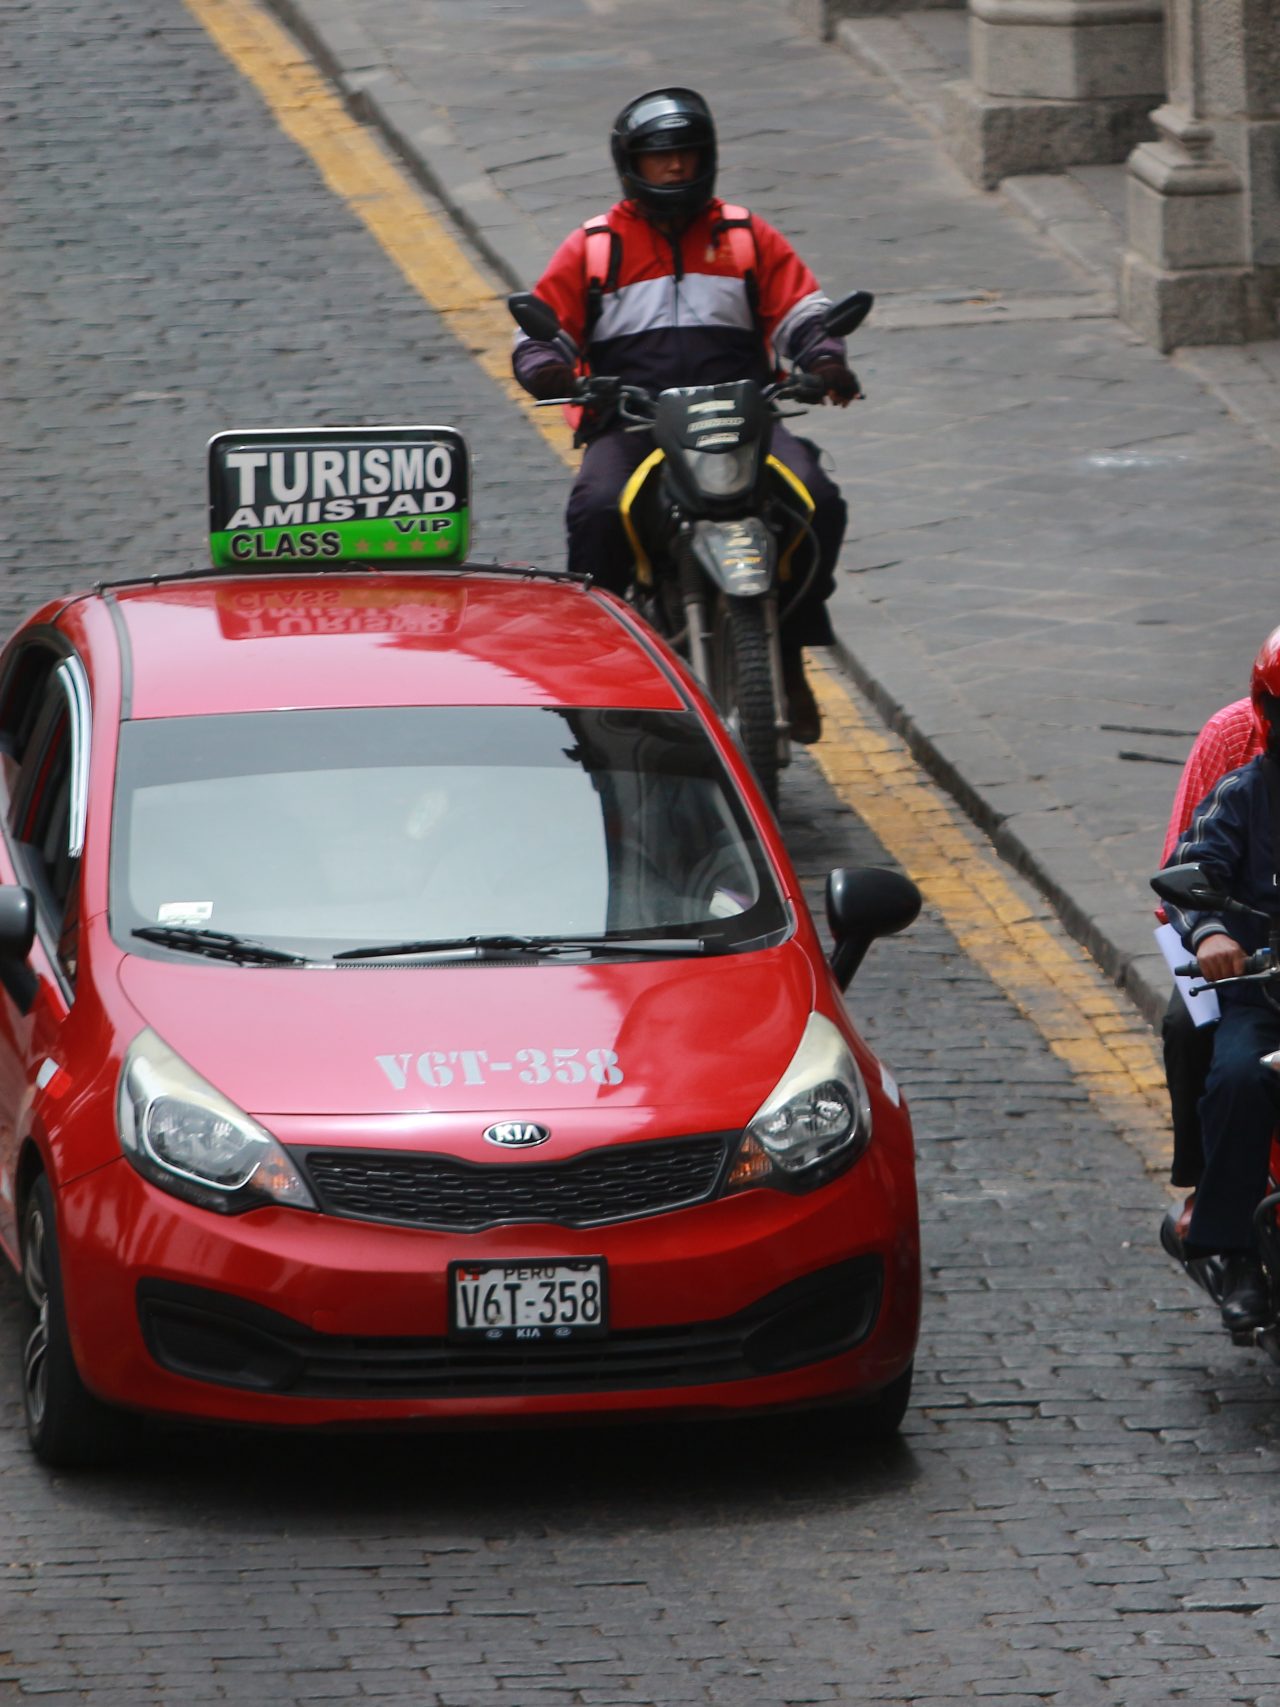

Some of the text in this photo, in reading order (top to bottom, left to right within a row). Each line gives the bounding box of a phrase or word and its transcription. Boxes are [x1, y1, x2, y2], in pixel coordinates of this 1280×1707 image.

[226, 447, 452, 505] TURISMO
[225, 491, 456, 530] AMISTAD
[394, 519, 451, 533] VIP
[231, 532, 340, 559] CLASS
[375, 1048, 625, 1090] V6T-358
[496, 1123, 542, 1142] KIA
[504, 1267, 556, 1281] PERU
[461, 1280, 599, 1326] V6T-358
[516, 1327, 541, 1338] KIA
